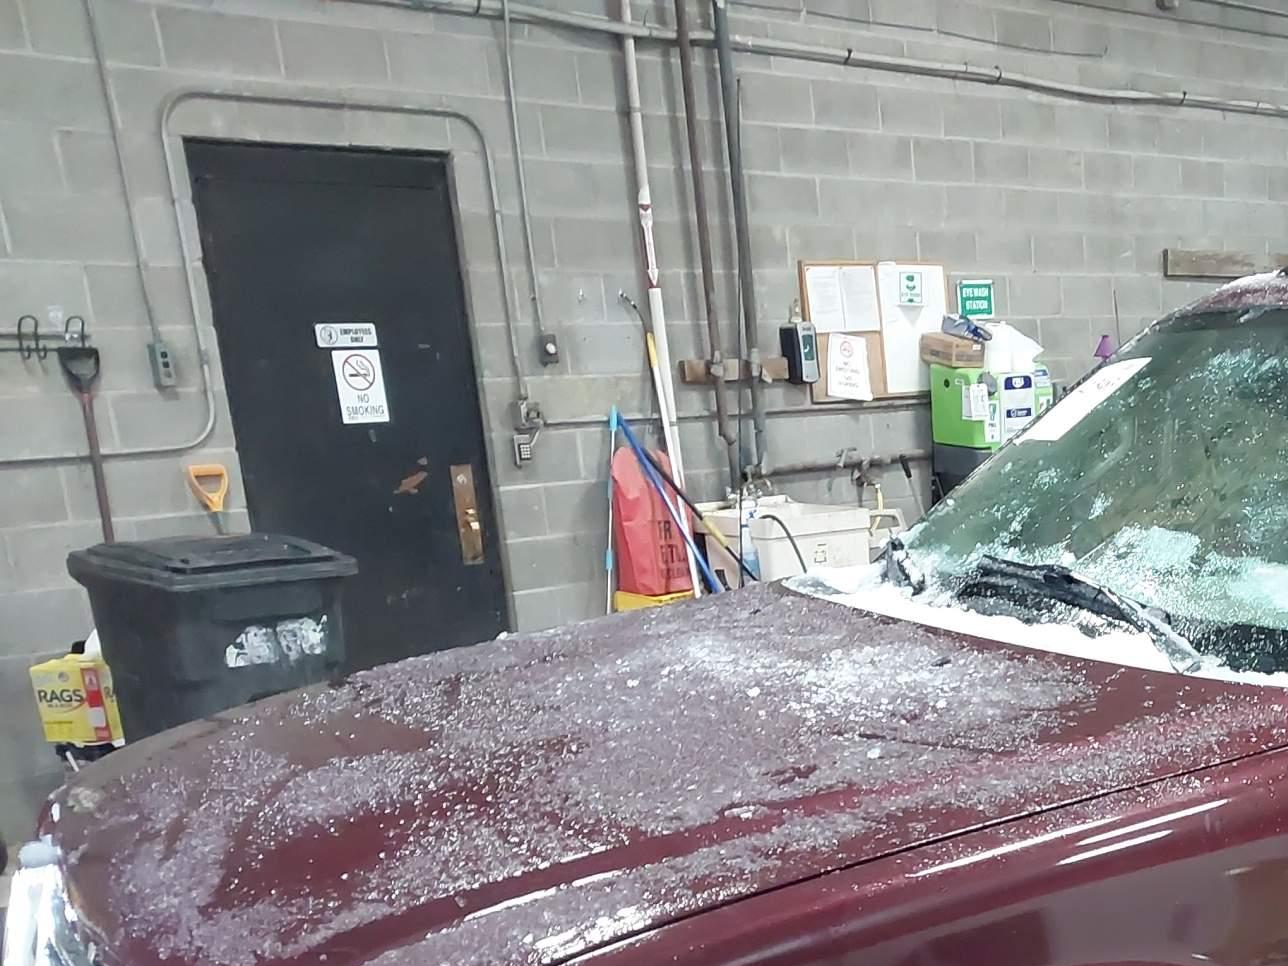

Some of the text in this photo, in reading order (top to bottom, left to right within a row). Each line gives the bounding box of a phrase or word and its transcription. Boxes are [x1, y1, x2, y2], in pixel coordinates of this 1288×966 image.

[340, 328, 372, 336] EMPLOYEES
[357, 393, 370, 403] NO
[346, 404, 385, 416] SMOKING
[37, 689, 84, 703] RAGS
